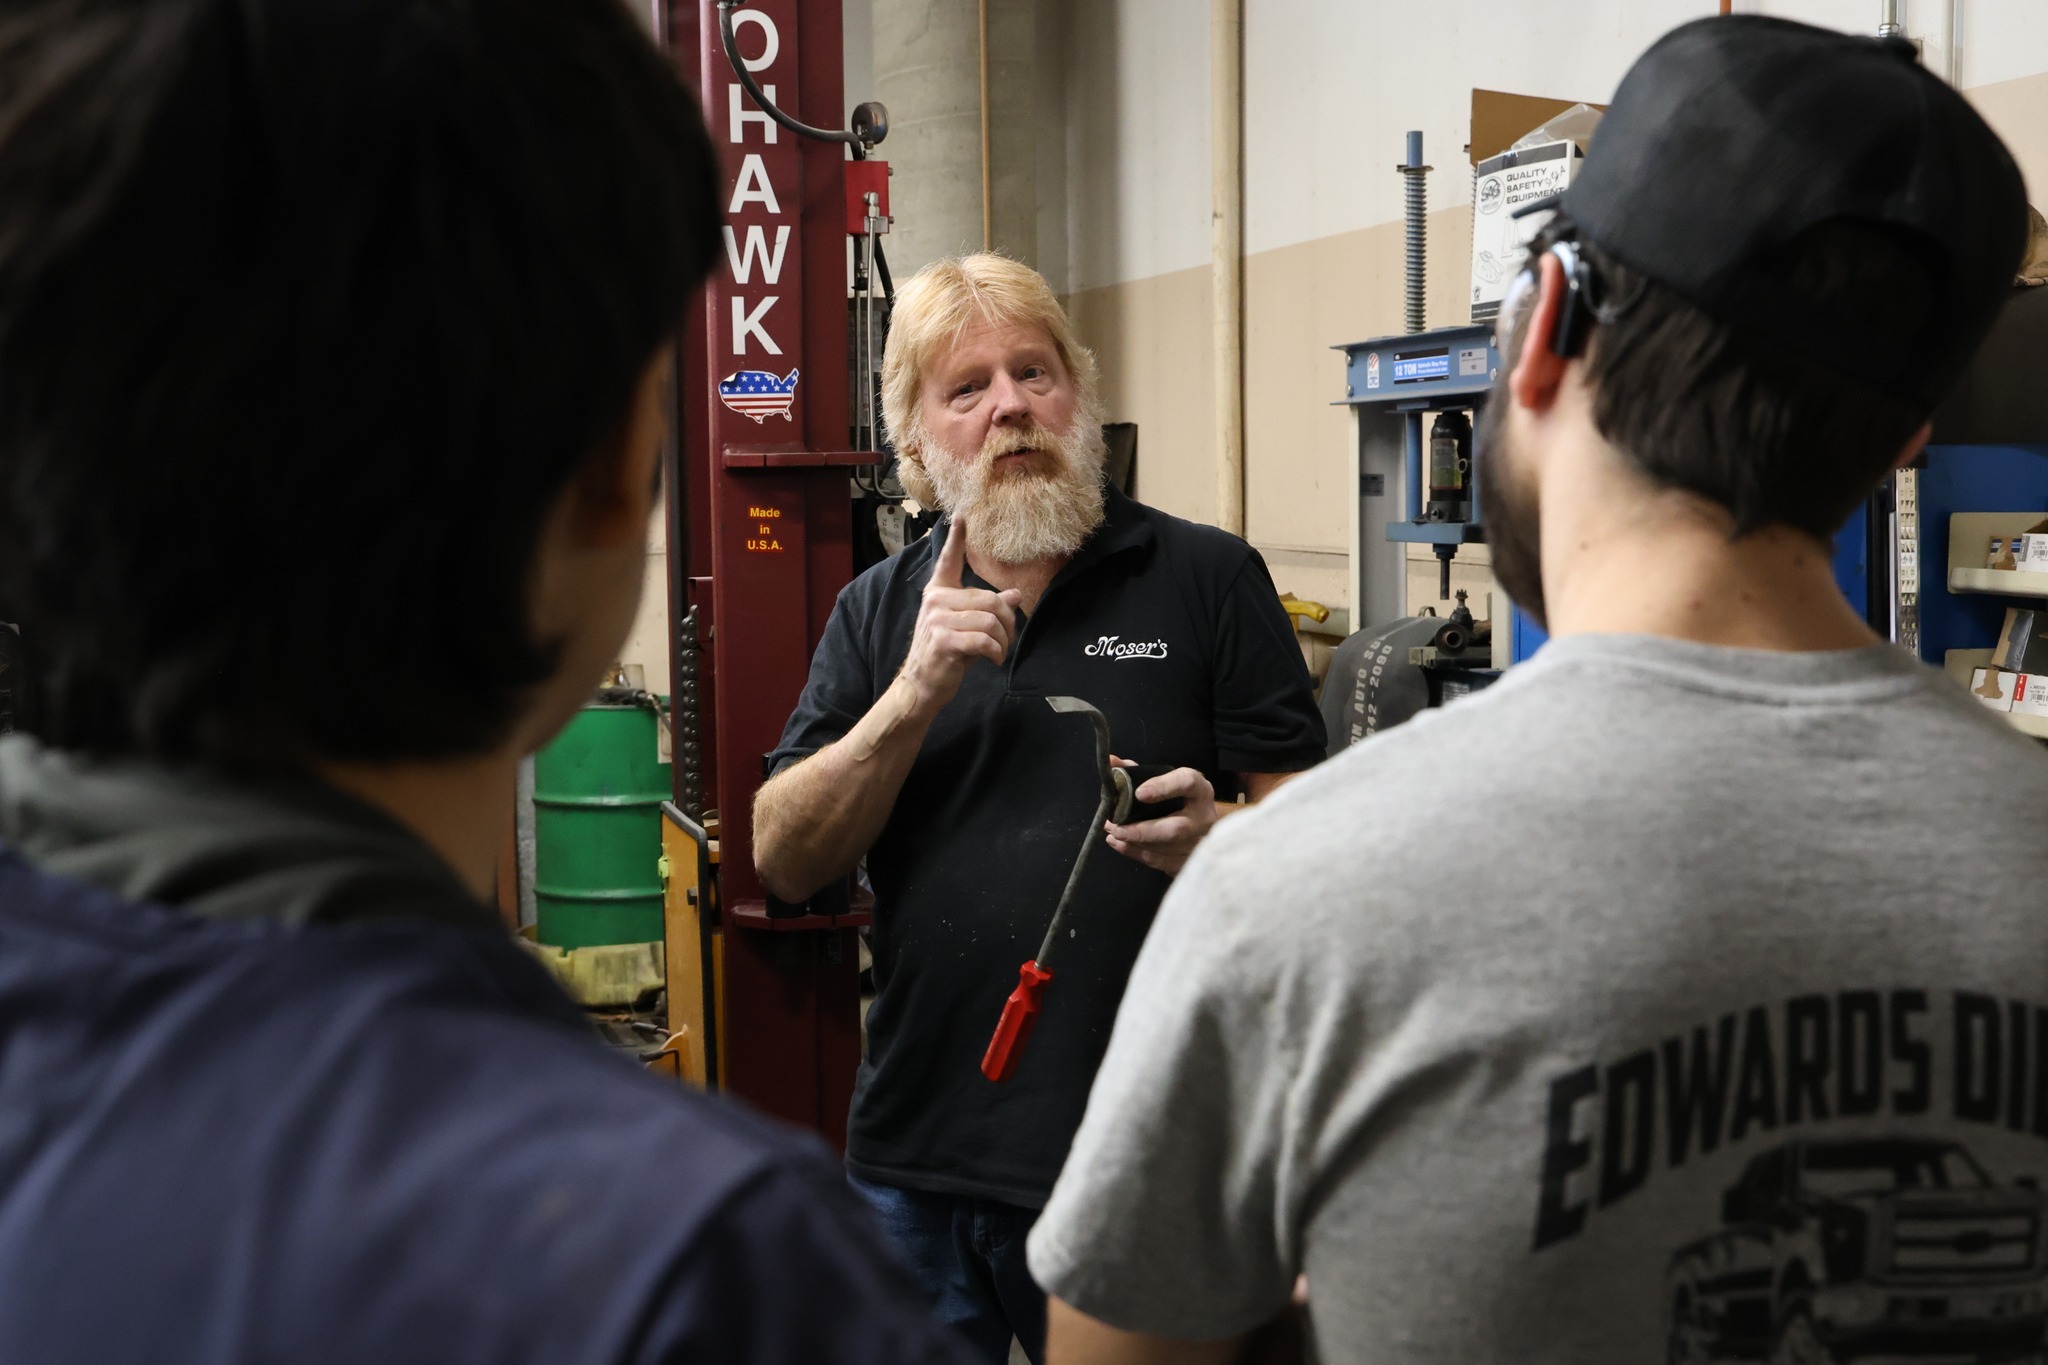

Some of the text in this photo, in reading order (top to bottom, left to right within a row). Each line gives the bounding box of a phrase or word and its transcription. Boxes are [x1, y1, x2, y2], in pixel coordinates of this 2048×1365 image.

[1506, 167, 1547, 182] QUALITY
[1506, 179, 1544, 193] SAFETY
[1395, 364, 1403, 376] 12
[1404, 362, 1417, 375] TON
[749, 507, 780, 518] Made
[759, 524, 770, 535] in
[747, 540, 783, 551] U.S.A.
[1084, 635, 1168, 662] Moser's
[1354, 668, 1367, 714] AUTO
[1532, 988, 1931, 1253] EDWARDS
